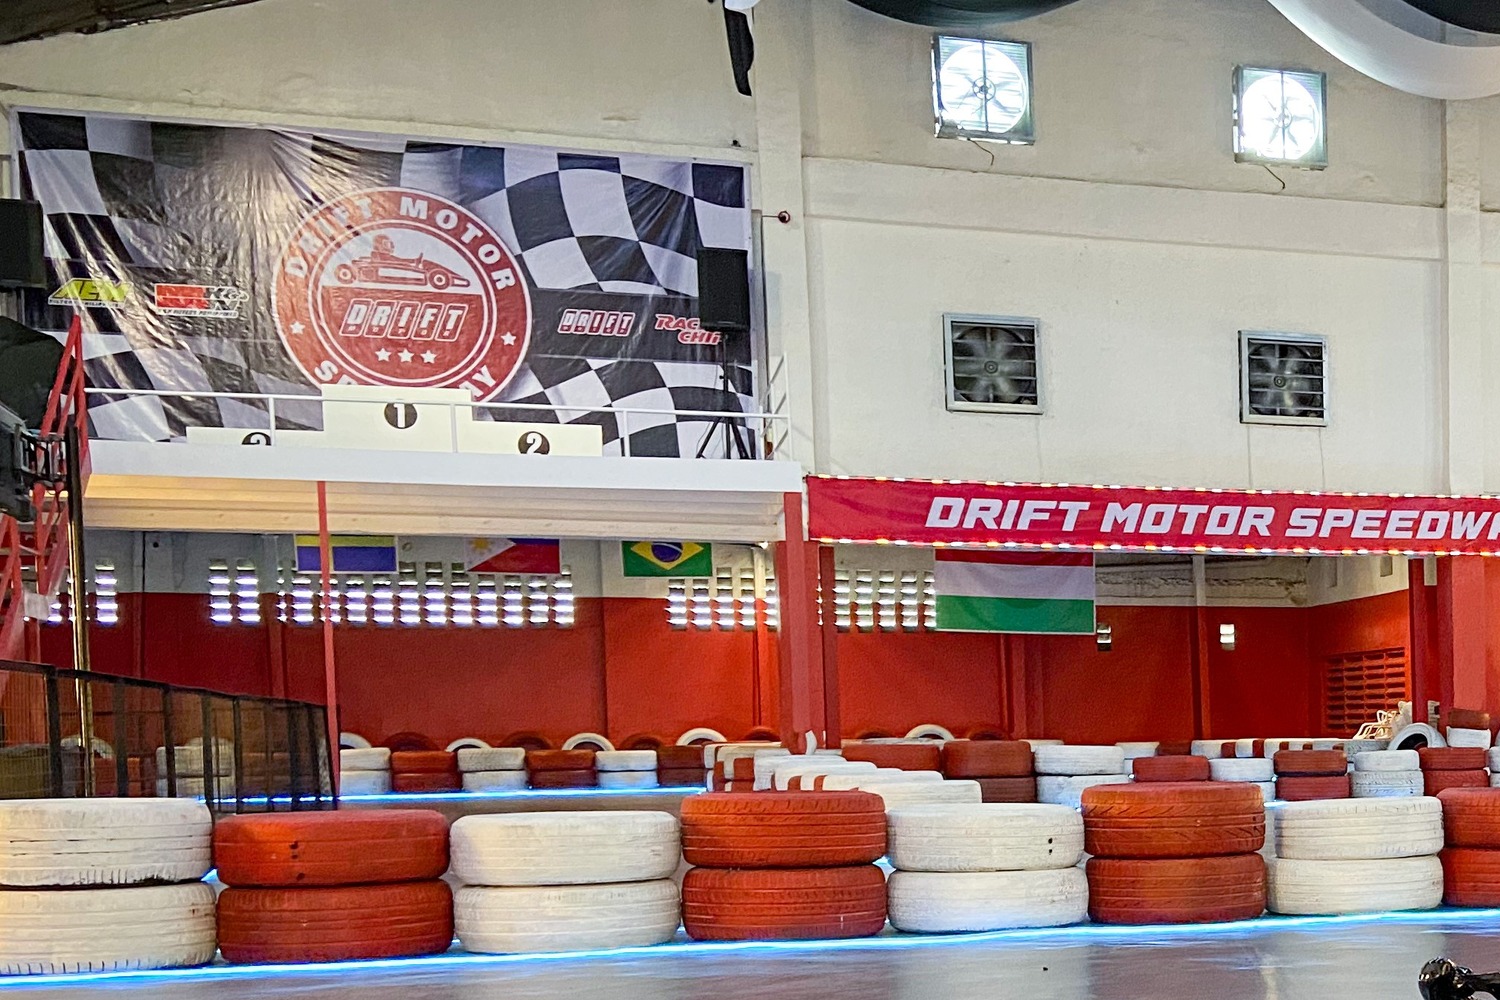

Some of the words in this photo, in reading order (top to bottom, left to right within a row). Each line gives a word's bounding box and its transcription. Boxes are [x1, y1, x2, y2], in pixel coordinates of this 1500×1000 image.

[285, 199, 373, 279] DRIFT
[399, 196, 516, 291] MOTOR
[345, 303, 464, 331] DRIFT
[560, 310, 635, 332] DRIFT
[655, 314, 701, 331] RAC
[393, 402, 406, 429] 1
[526, 432, 543, 456] 2
[924, 496, 1090, 532] DRIFT
[1100, 502, 1275, 537] MOTOR
